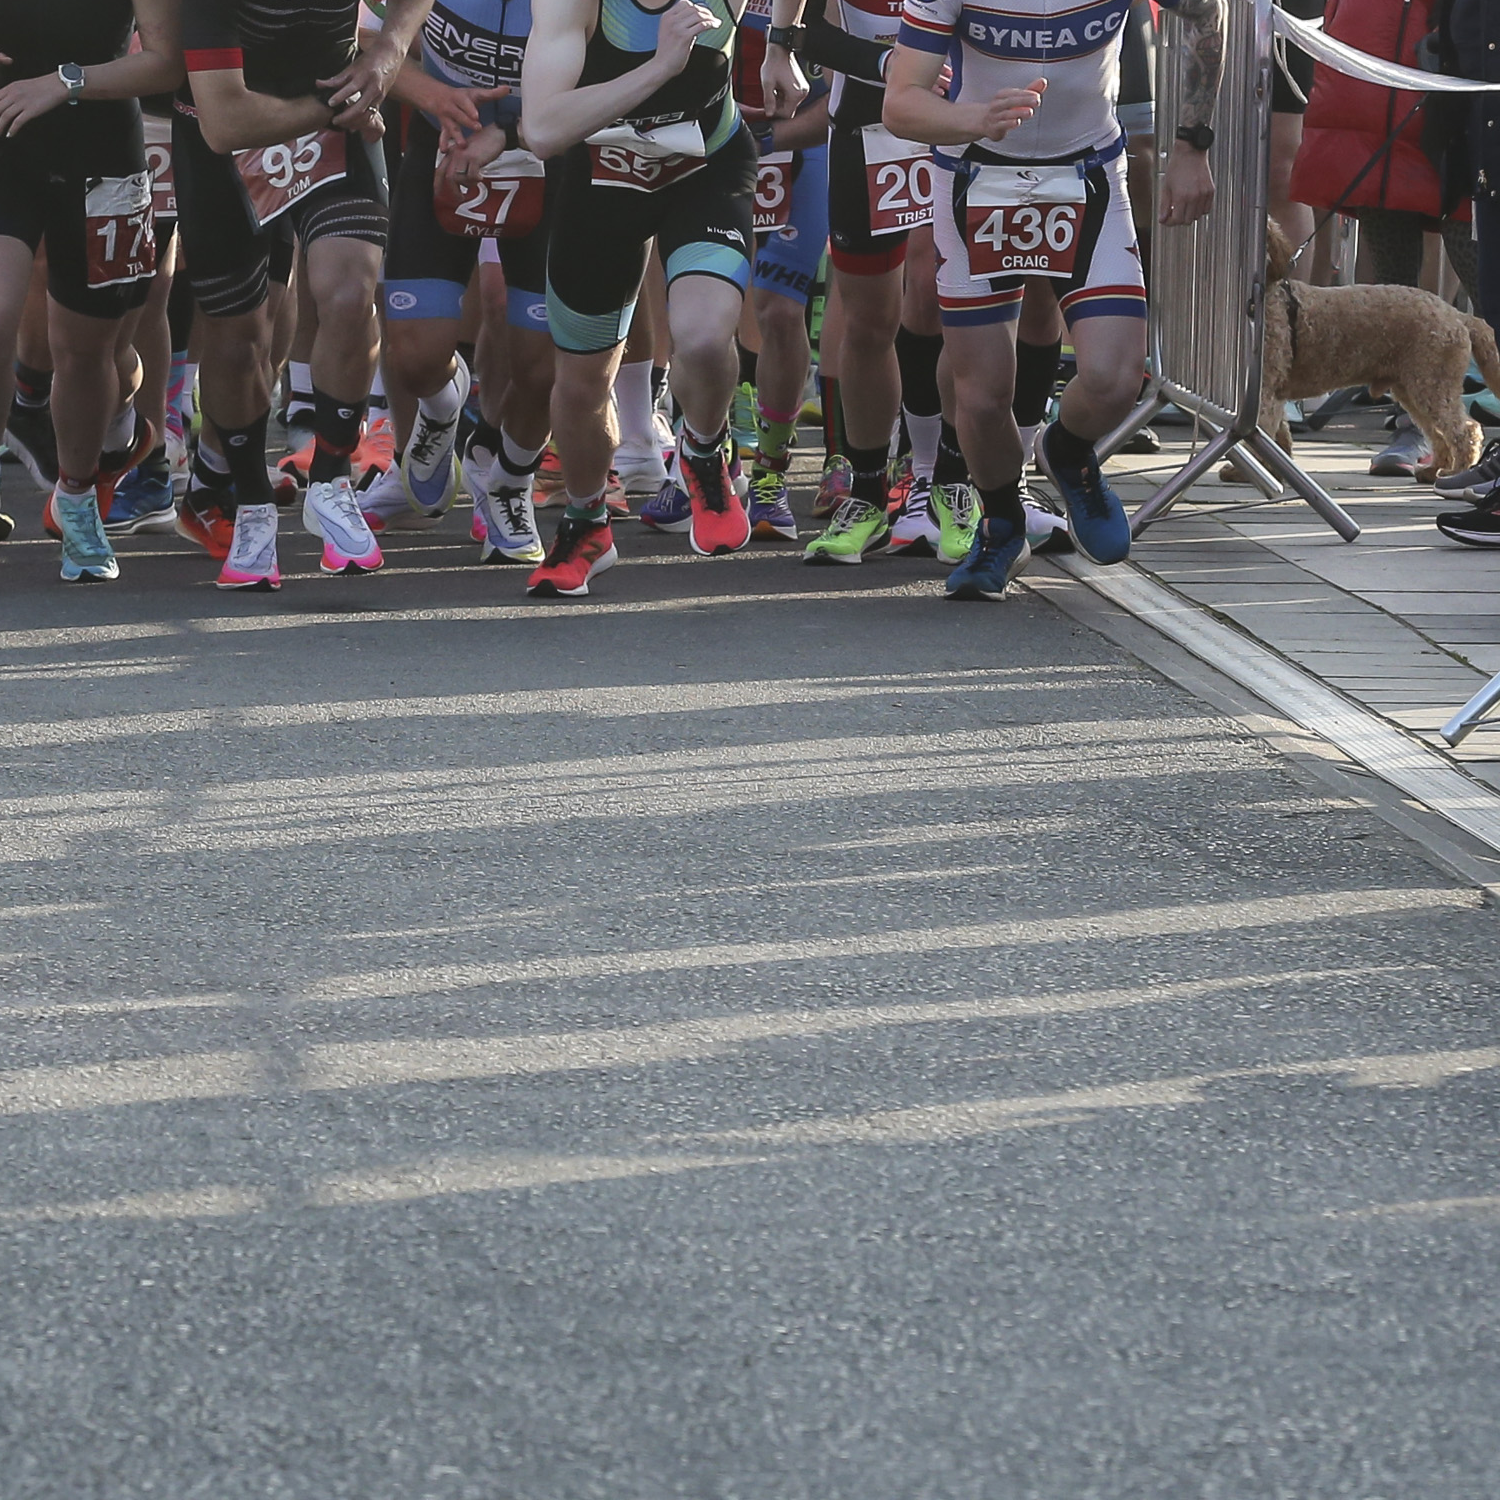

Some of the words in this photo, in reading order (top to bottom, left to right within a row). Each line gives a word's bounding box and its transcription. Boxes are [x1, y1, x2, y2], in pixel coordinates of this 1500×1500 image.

[968, 21, 1078, 49] BYNEA
[1083, 11, 1122, 41] CC
[261, 131, 322, 189] 95
[286, 176, 311, 200] TOM
[454, 180, 520, 225] 27
[463, 223, 503, 237] KYLE
[974, 205, 1077, 252] 436
[1001, 255, 1049, 269] CRAIG
